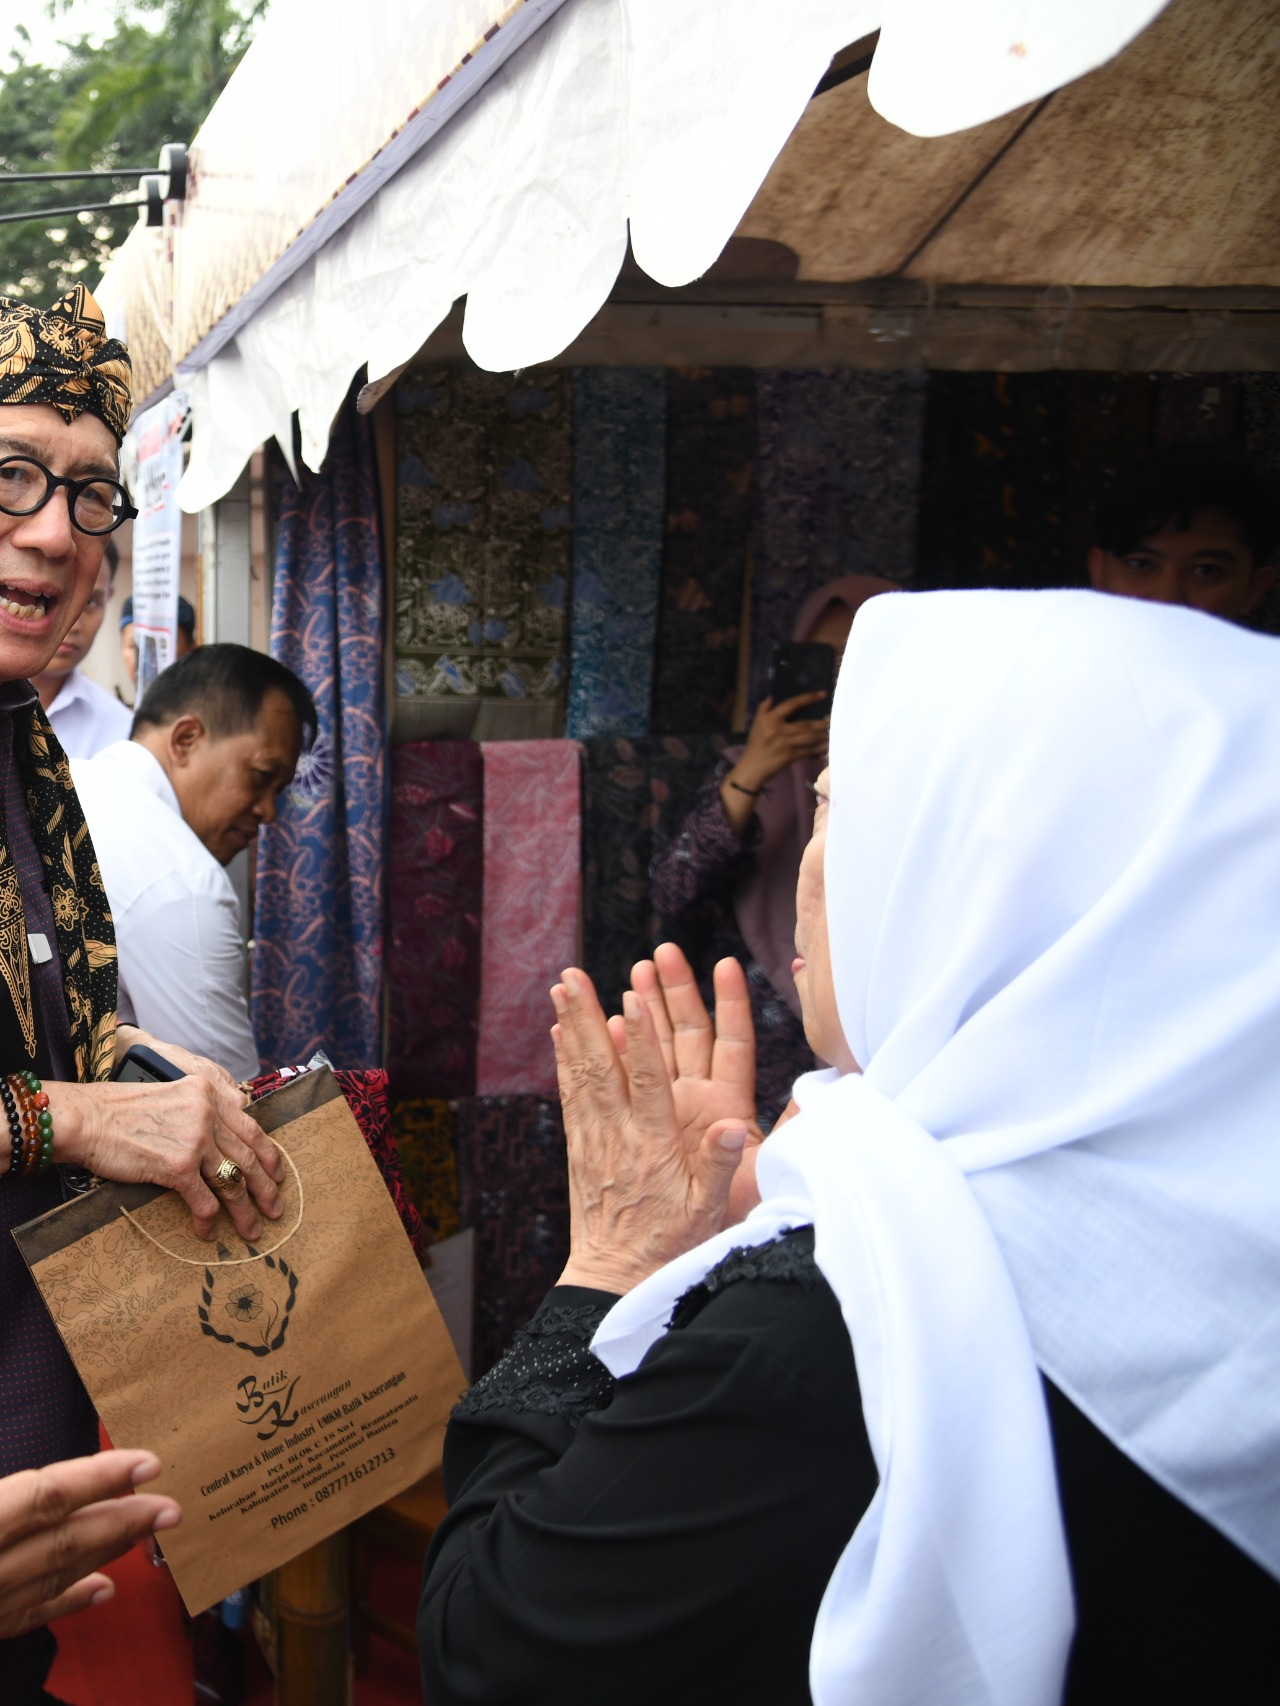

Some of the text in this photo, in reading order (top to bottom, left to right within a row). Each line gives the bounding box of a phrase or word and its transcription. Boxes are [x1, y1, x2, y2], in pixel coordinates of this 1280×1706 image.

[236, 1370, 287, 1413] Batik
[236, 1376, 351, 1440] Kaserangan
[200, 1371, 407, 1497] Central Karya & Home Industri UMKM Batik Kaserangan
[240, 1418, 399, 1514] Kabupaten Serang Provinsi Banten
[267, 1463, 284, 1477] PCI
[288, 1446, 312, 1464] BLOK
[314, 1440, 321, 1449] C
[324, 1431, 335, 1442] 18
[209, 1490, 257, 1521] Kelurahan
[261, 1463, 303, 1491] Harjatani
[307, 1431, 357, 1464] Kecamatan
[270, 1502, 308, 1530] Phone
[315, 1447, 396, 1503] 087771612713
[302, 1461, 346, 1489] Indonesia
